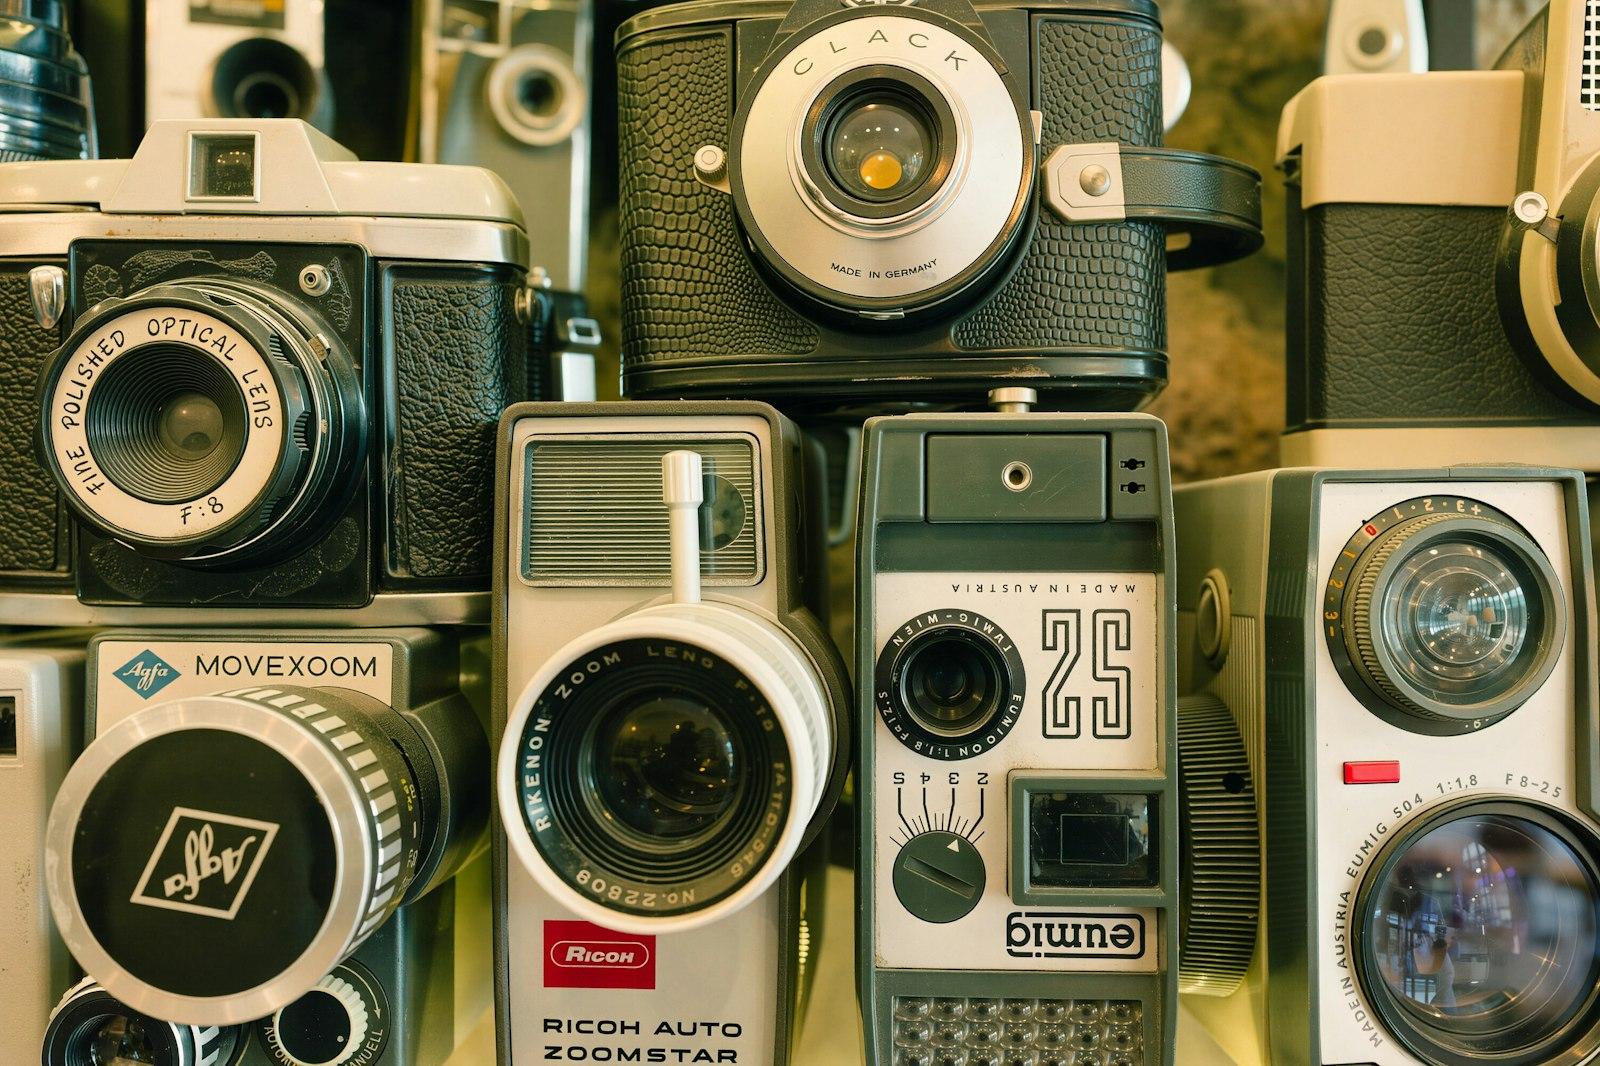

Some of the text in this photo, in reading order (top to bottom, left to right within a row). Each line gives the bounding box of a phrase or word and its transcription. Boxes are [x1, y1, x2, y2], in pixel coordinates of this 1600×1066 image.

[793, 29, 968, 76] CLACK
[830, 258, 938, 279] MADE IN GERMANY
[61, 316, 273, 496] FINE POLISHED OPTICAL LENS
[180, 496, 224, 525] F:8
[951, 584, 1136, 594] MADE IN AUSTRIA
[121, 654, 378, 691] Agfa MOVEXOOM
[525, 716, 552, 833] RIKENON
[554, 651, 621, 700] ZOOM
[893, 772, 989, 785] 2 3 4 5
[163, 823, 257, 901] Agfa
[1345, 821, 1389, 880] EUMIG
[1006, 918, 1137, 957] eumig
[1334, 889, 1384, 1049] MADE IN AUSTRIA
[543, 1018, 743, 1038] RICOH AUTO
[543, 1045, 738, 1064] ZOOMSTAR
